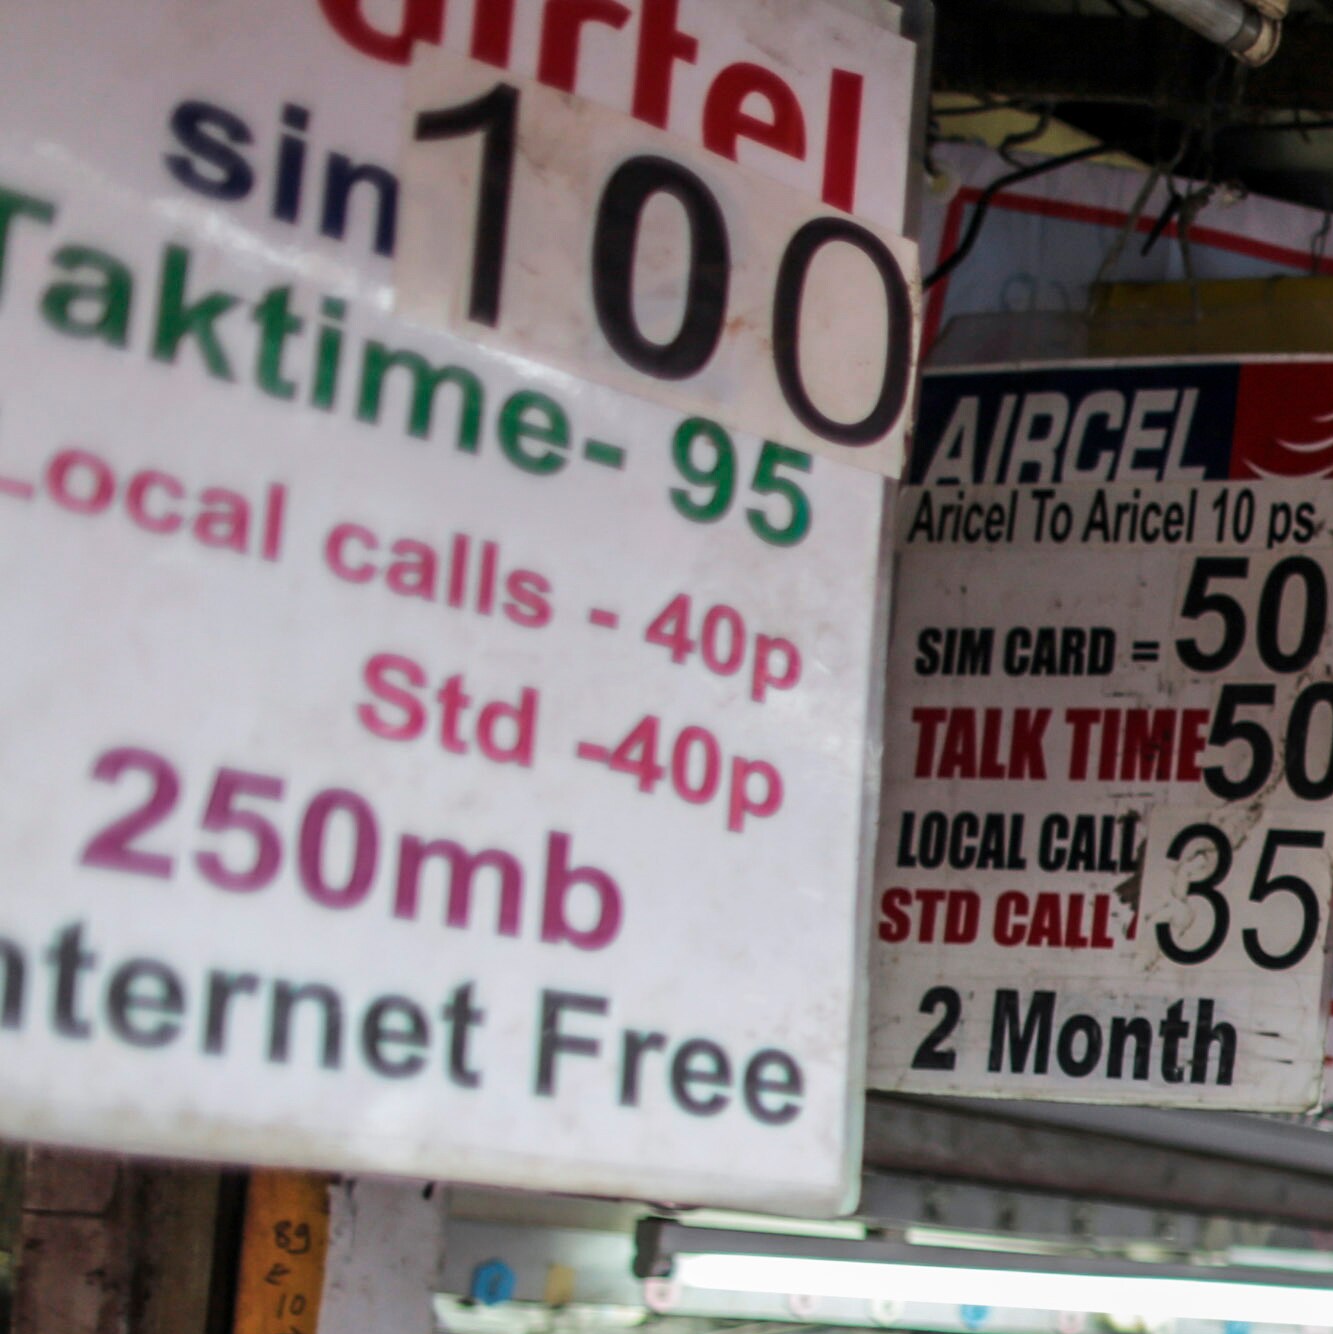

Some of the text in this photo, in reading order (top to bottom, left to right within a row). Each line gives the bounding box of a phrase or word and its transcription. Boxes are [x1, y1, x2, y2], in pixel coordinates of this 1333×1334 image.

[413, 82, 913, 449] 100
[670, 417, 813, 548] 95
[923, 387, 1207, 484] AIRCEL
[0, 449, 286, 561] ocal
[324, 523, 554, 629] calls
[646, 592, 802, 702] 40p
[907, 489, 1015, 543] Aricel
[1032, 488, 1071, 542] To
[1082, 490, 1196, 542] Aricel
[1213, 488, 1252, 542] 10
[915, 628, 993, 676] SIM
[1004, 628, 1116, 676] CARD
[1175, 556, 1327, 673] 50
[356, 652, 784, 832] Std -40p
[912, 708, 1052, 781] TALK
[1066, 709, 1210, 782] TIME
[80, 747, 624, 951] 250mb
[898, 812, 1138, 873] LOCAL CALL
[1156, 823, 1325, 970] 35
[878, 888, 980, 945] STD
[534, 989, 804, 1127] Free
[912, 987, 1237, 1085] 2 Month
